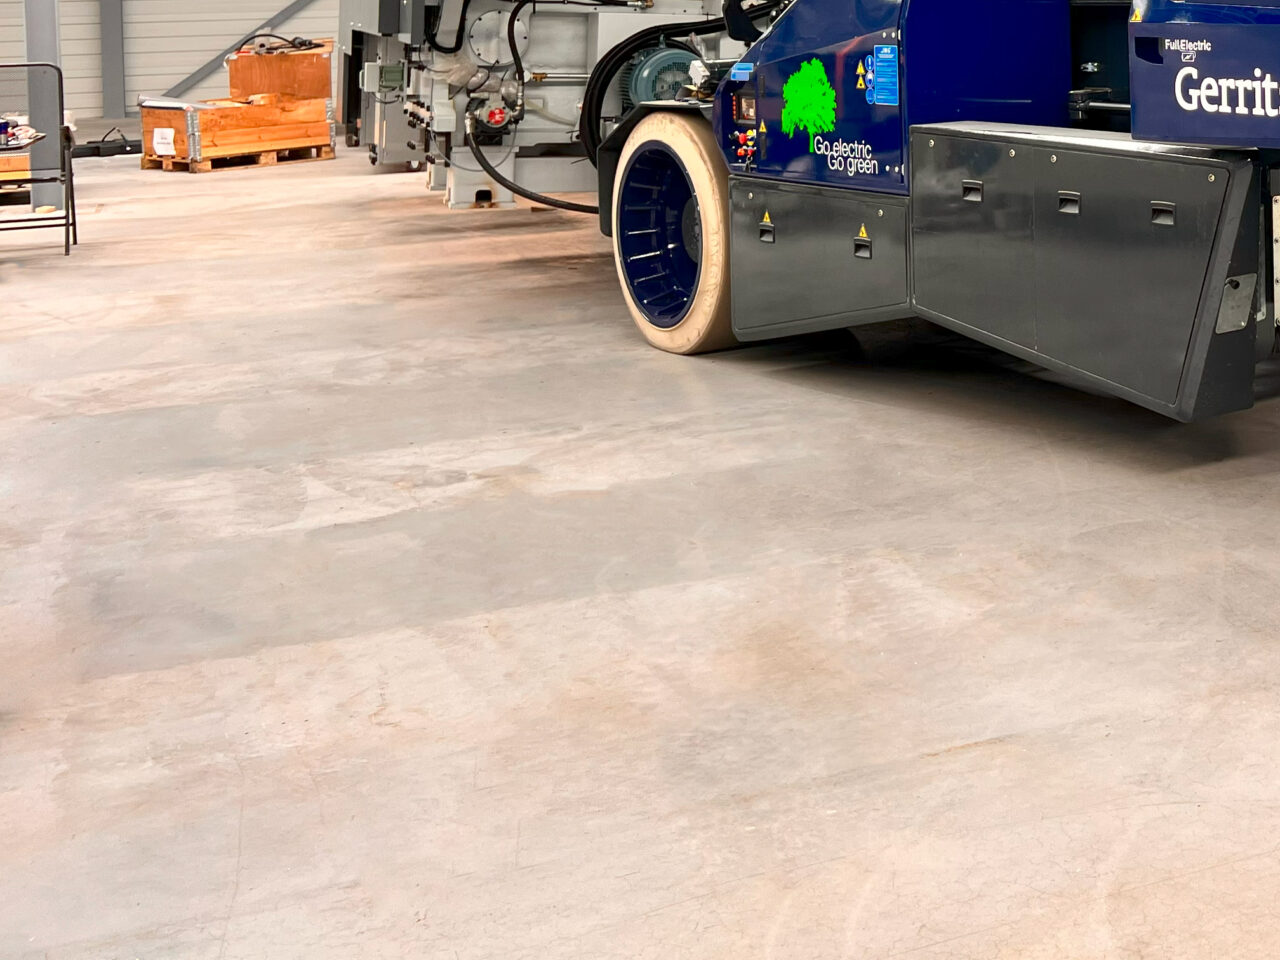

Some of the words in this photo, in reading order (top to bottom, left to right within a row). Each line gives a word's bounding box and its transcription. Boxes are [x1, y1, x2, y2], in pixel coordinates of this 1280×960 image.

[814, 135, 831, 155] Go
[832, 138, 872, 159] electric
[827, 151, 845, 170] Go
[846, 157, 879, 177] green
